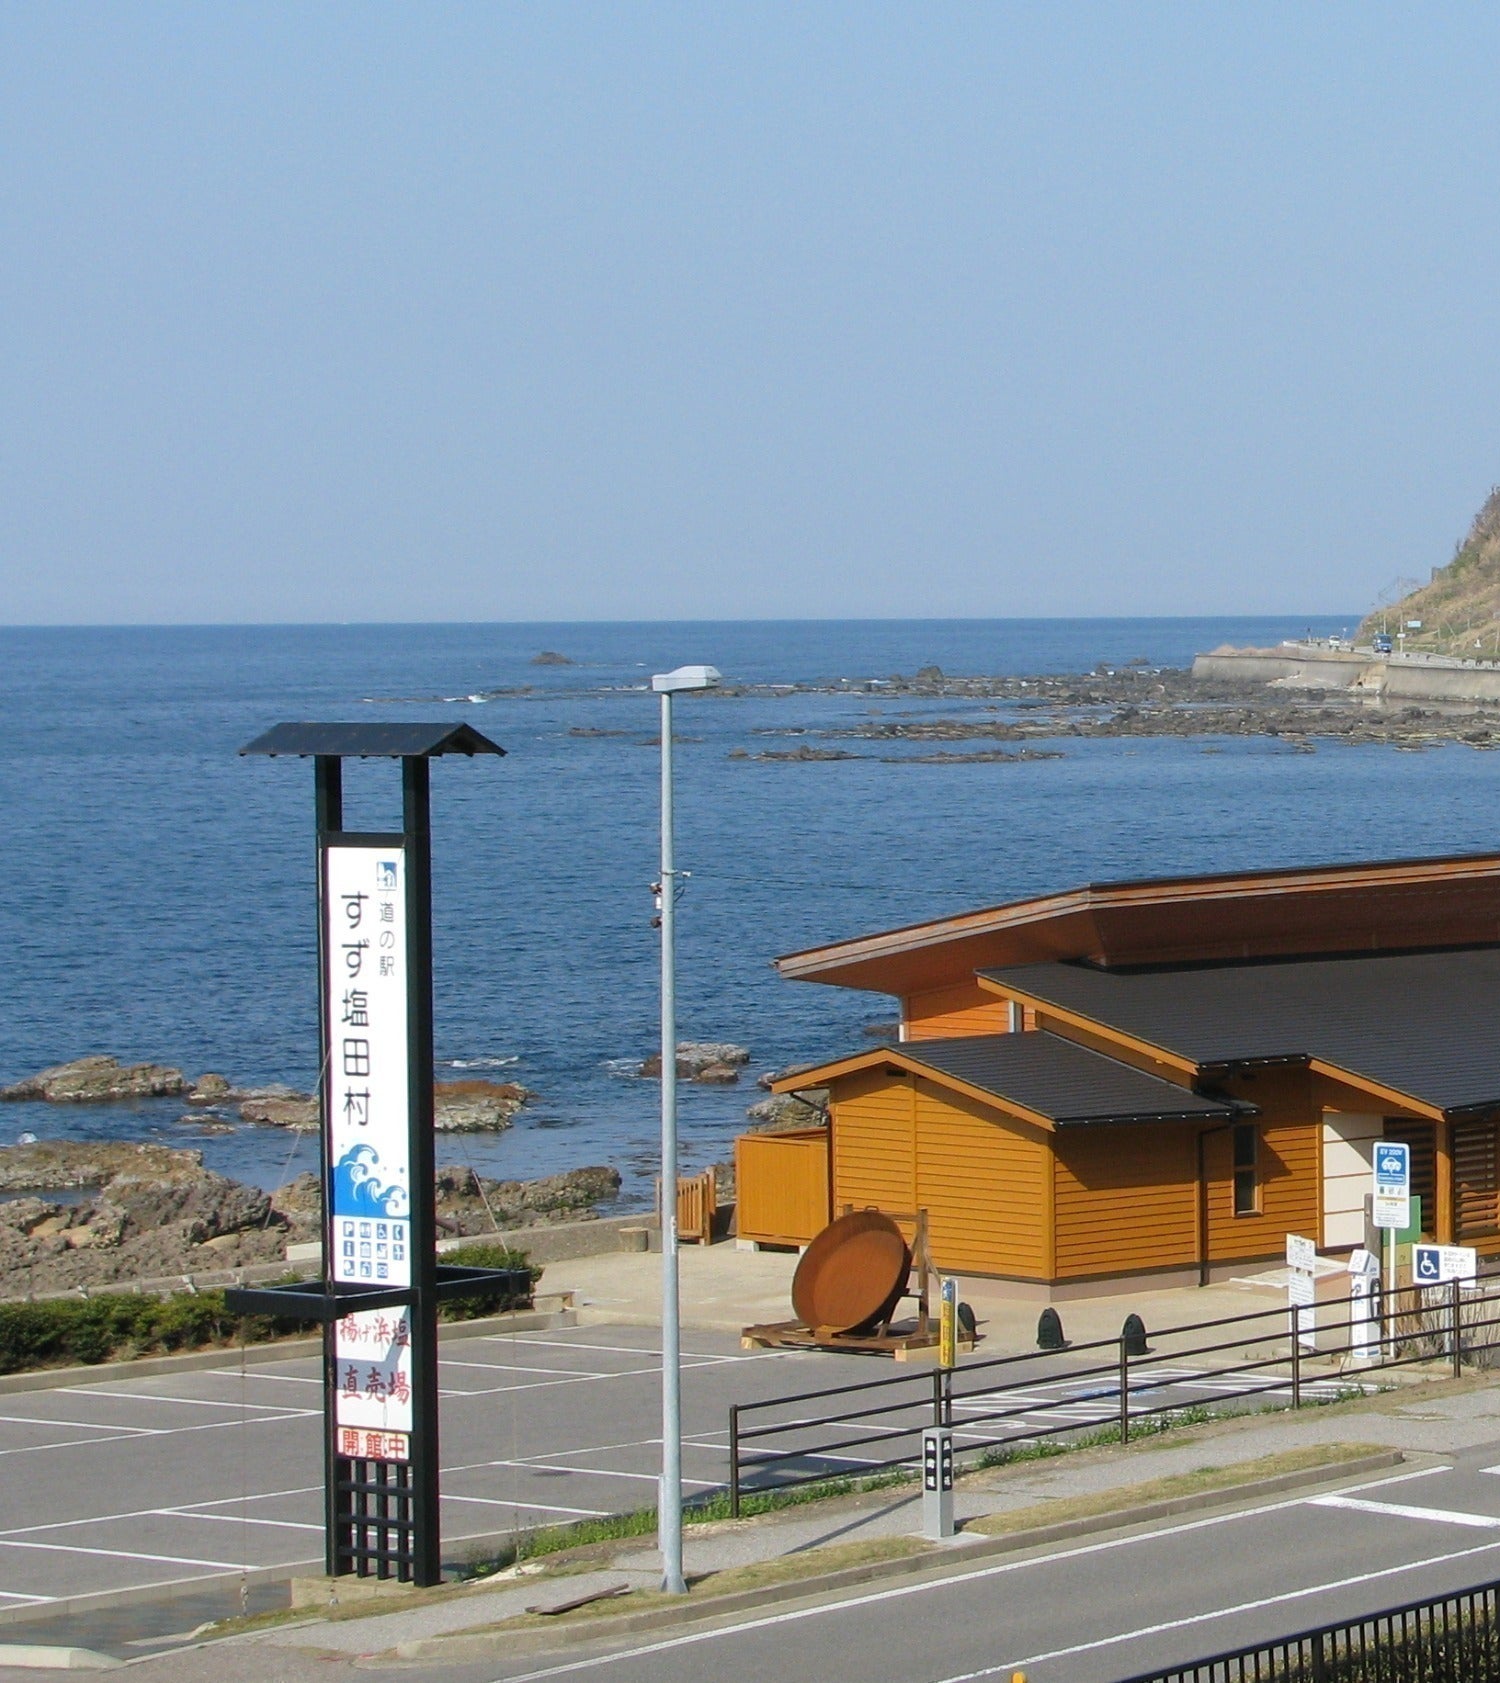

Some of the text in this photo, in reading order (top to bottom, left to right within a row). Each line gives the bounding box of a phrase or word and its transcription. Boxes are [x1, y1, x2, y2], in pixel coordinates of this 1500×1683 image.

[377, 900, 396, 978] 道の駅
[340, 891, 370, 1127] すず塩田村
[341, 1365, 411, 1405] 直売場
[342, 1430, 405, 1460] 開館中
